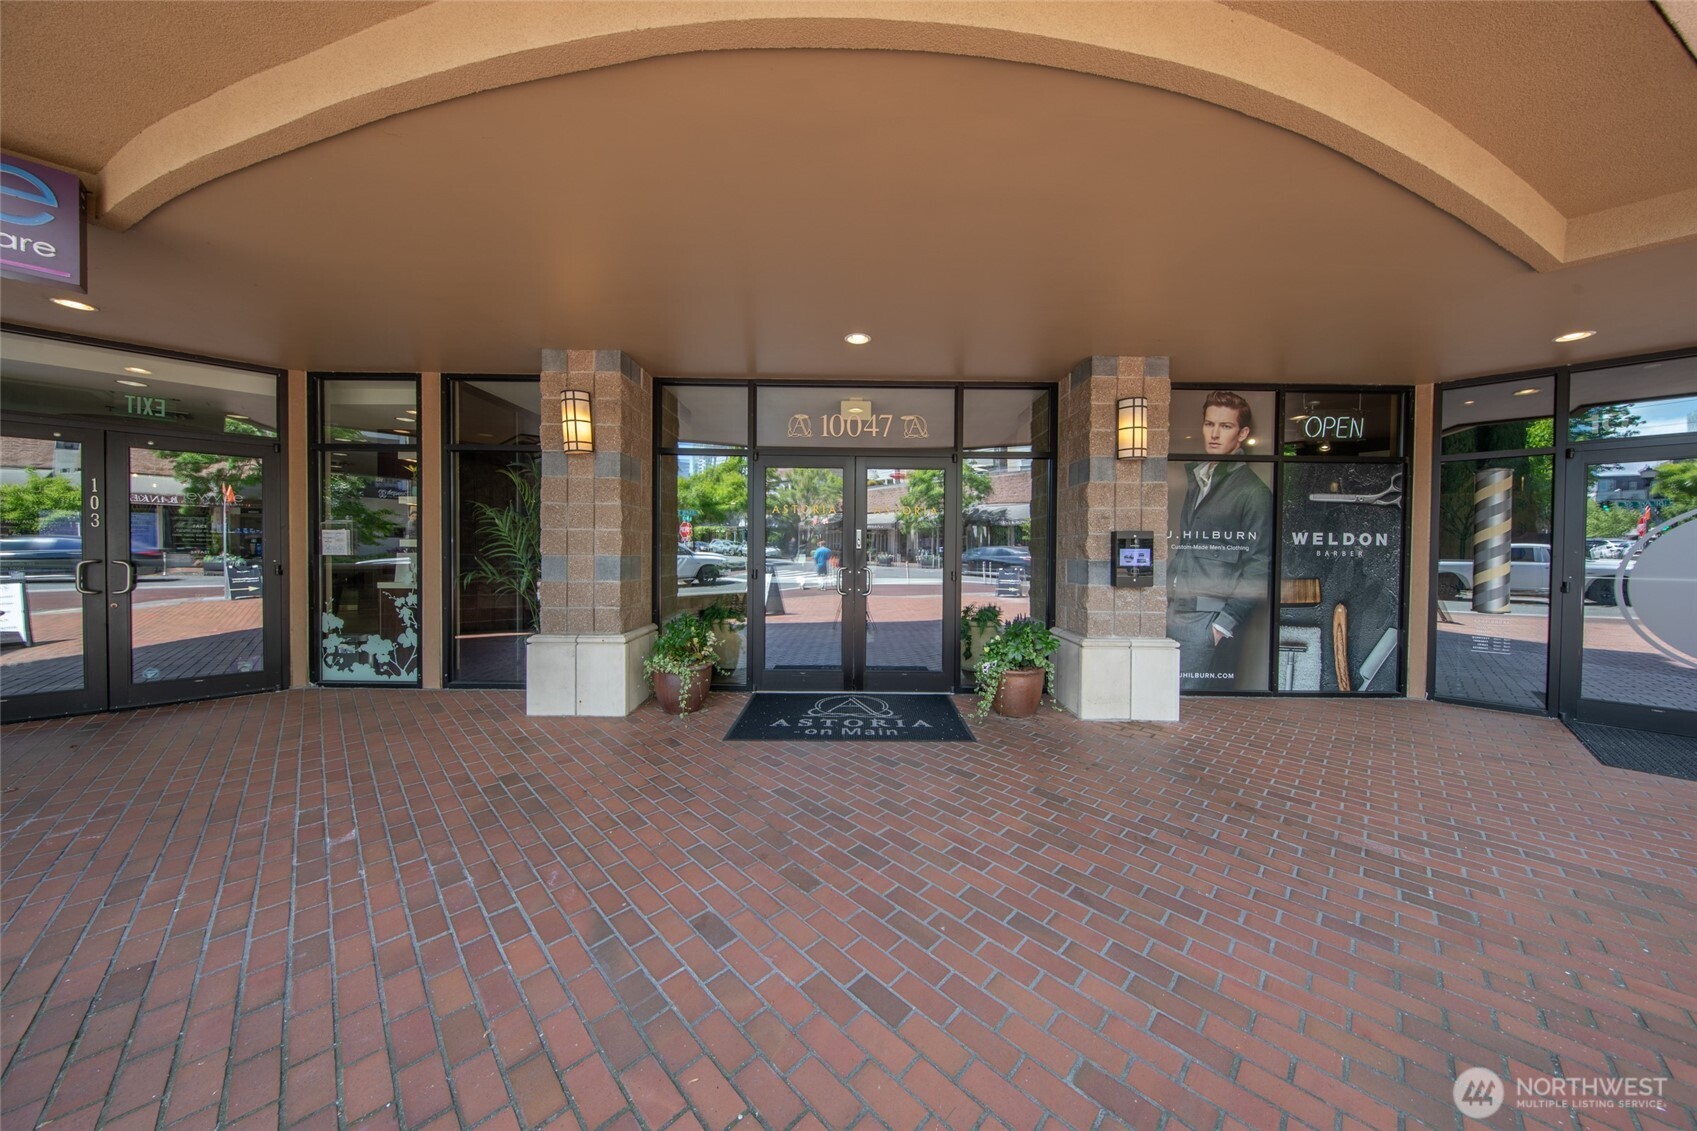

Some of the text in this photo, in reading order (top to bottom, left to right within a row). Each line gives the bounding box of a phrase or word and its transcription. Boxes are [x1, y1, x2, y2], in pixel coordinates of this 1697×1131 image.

[819, 414, 893, 438] 10047
[1304, 416, 1364, 439] OPEN
[772, 505, 837, 514] ASTORIA
[1291, 532, 1388, 546] WELDON
[769, 717, 934, 729] ASTORIA
